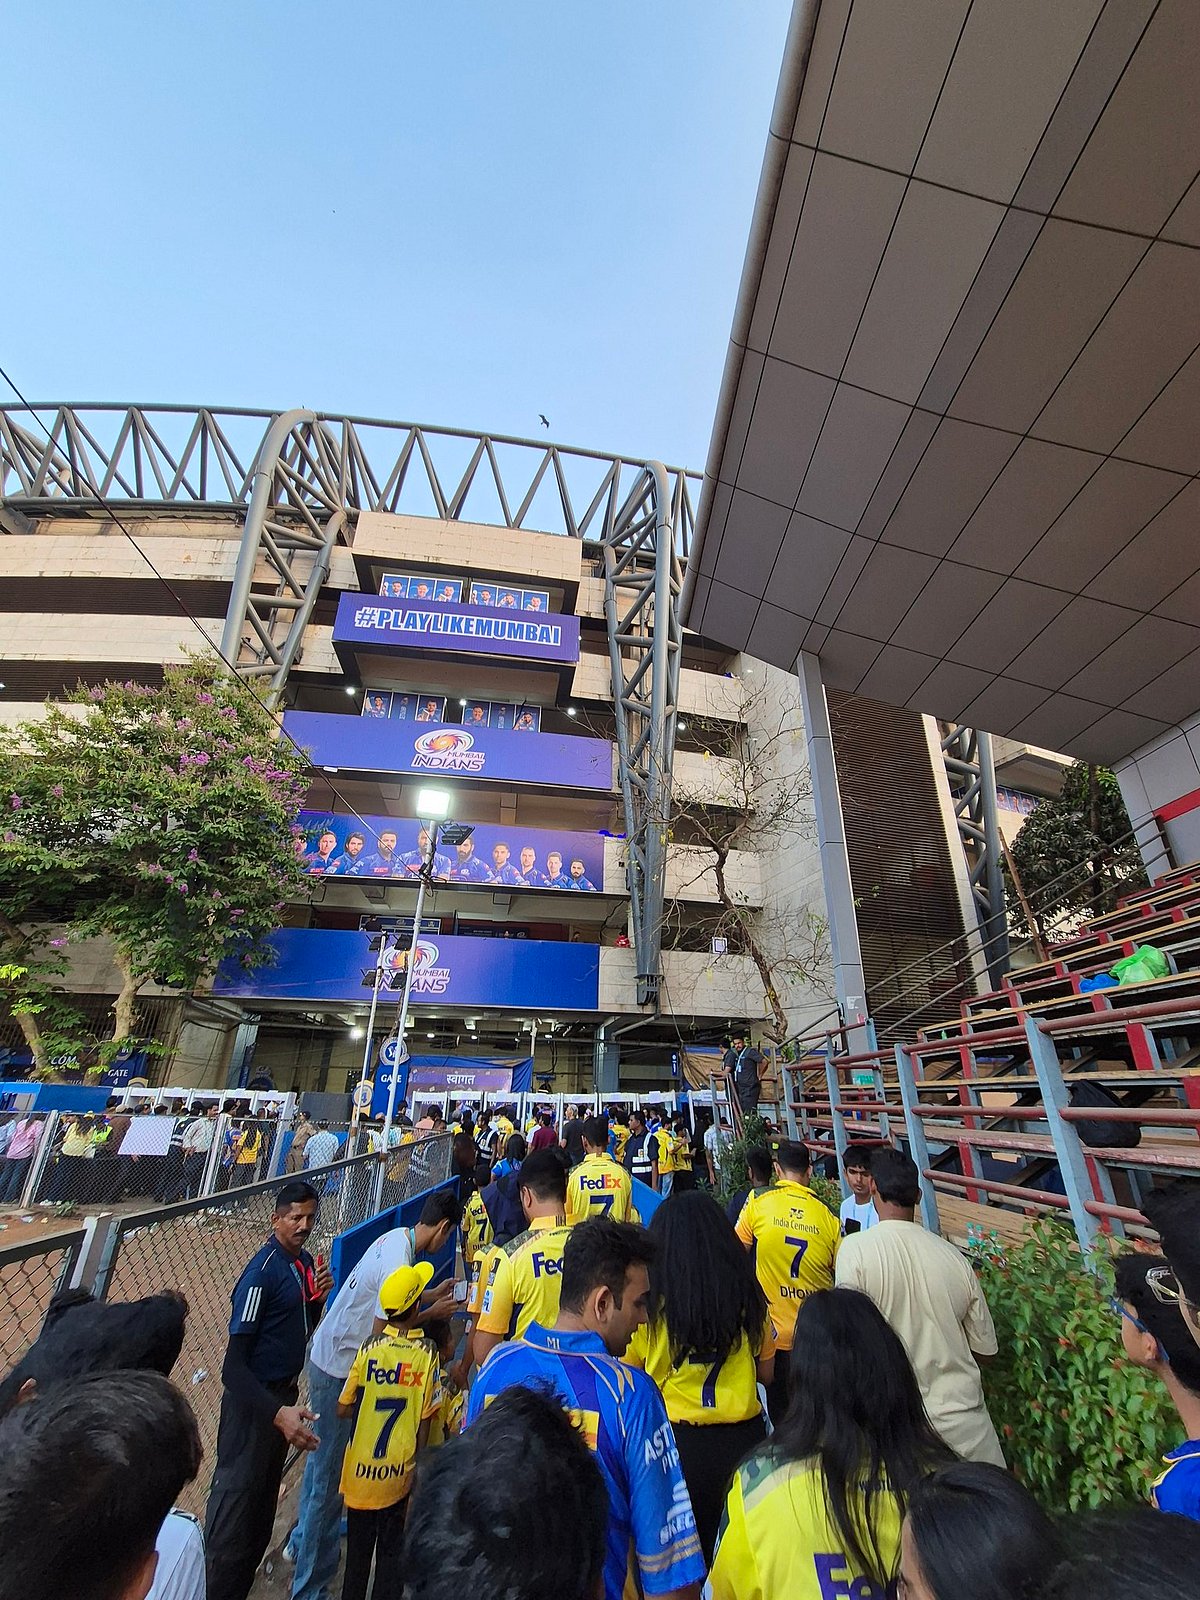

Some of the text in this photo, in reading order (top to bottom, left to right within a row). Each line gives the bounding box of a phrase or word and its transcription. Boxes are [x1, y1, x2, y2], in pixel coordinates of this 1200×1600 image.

[355, 607, 561, 646] #PLAYLIKEMUMBAI
[413, 756, 483, 770] INDIANS
[447, 752, 485, 760] MUMBAI
[107, 1069, 128, 1077] GATE
[380, 1074, 401, 1083] GAE
[446, 1074, 475, 1085] स्वागत
[580, 1174, 621, 1190] FedEx
[589, 1195, 614, 1217] 7
[476, 1218, 488, 1242] 7
[773, 1216, 820, 1235] India Cements
[784, 1235, 808, 1279] 7
[546, 1335, 560, 1350] MI
[366, 1359, 424, 1387] FedEx
[688, 1350, 726, 1408] 7
[373, 1396, 408, 1459] 7
[644, 1421, 676, 1466] AST
[355, 1462, 405, 1480] DHONI
